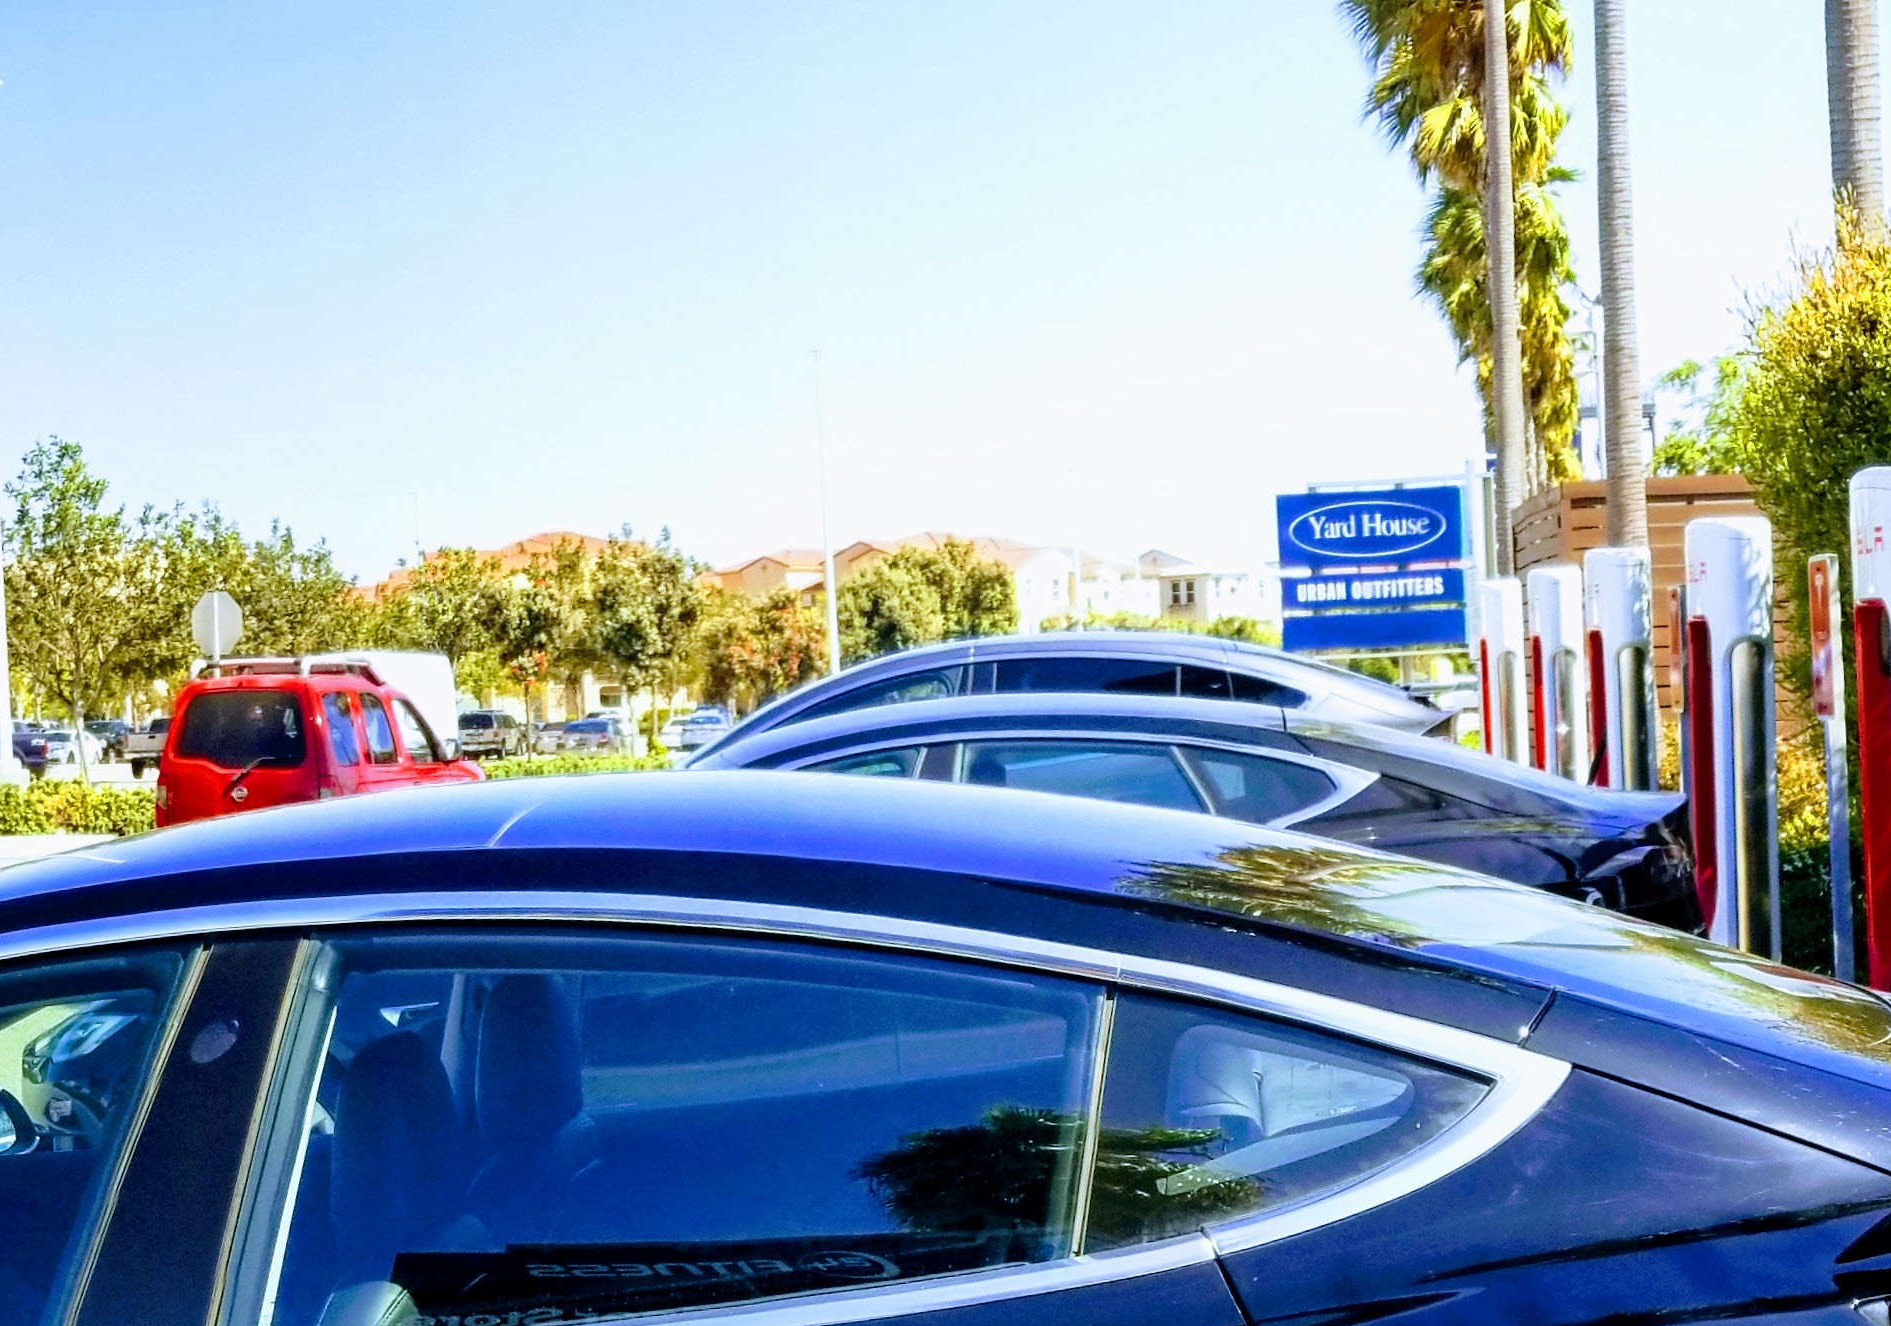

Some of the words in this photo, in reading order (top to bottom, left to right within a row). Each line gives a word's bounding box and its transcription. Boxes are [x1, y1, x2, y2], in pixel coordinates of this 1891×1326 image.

[1308, 514, 1356, 539] Yard
[1361, 513, 1431, 537] House
[1297, 582, 1347, 602] URBAN
[1351, 576, 1444, 600] OUTFITTERS
